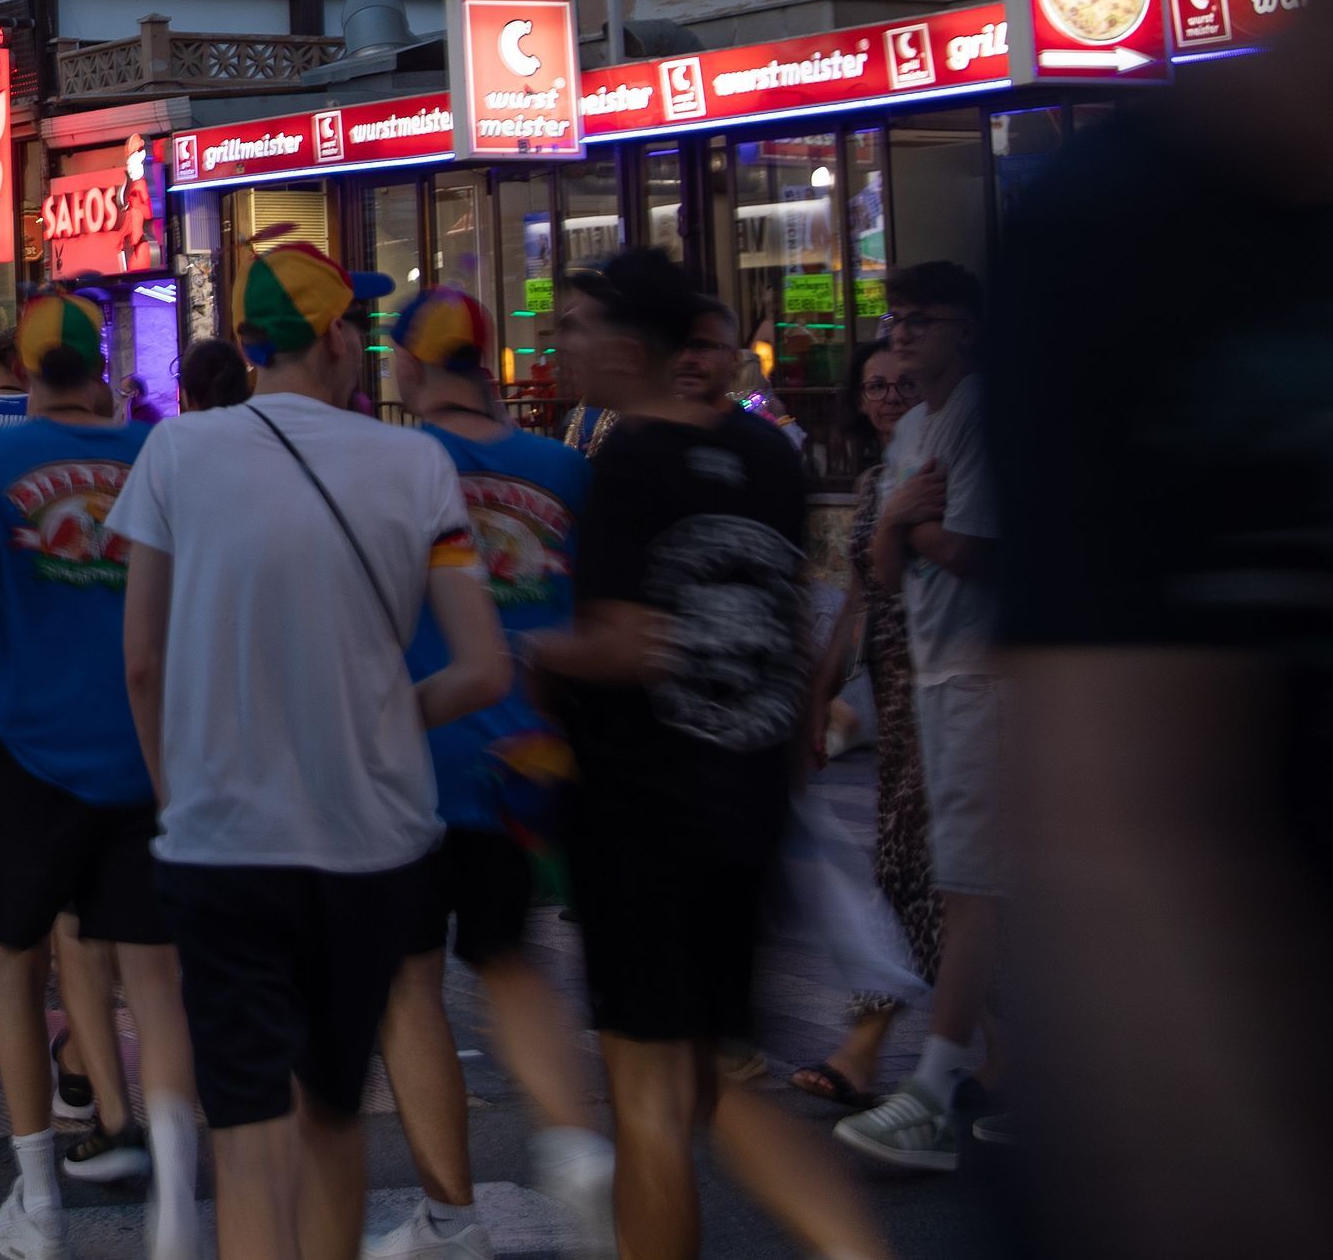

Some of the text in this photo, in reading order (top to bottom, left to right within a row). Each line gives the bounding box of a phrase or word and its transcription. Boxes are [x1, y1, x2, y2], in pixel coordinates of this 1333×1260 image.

[485, 89, 560, 110] wurst
[580, 84, 653, 116] eister
[478, 113, 570, 138] meister
[202, 132, 303, 171] grillmeister
[43, 186, 118, 241] SAFOS
